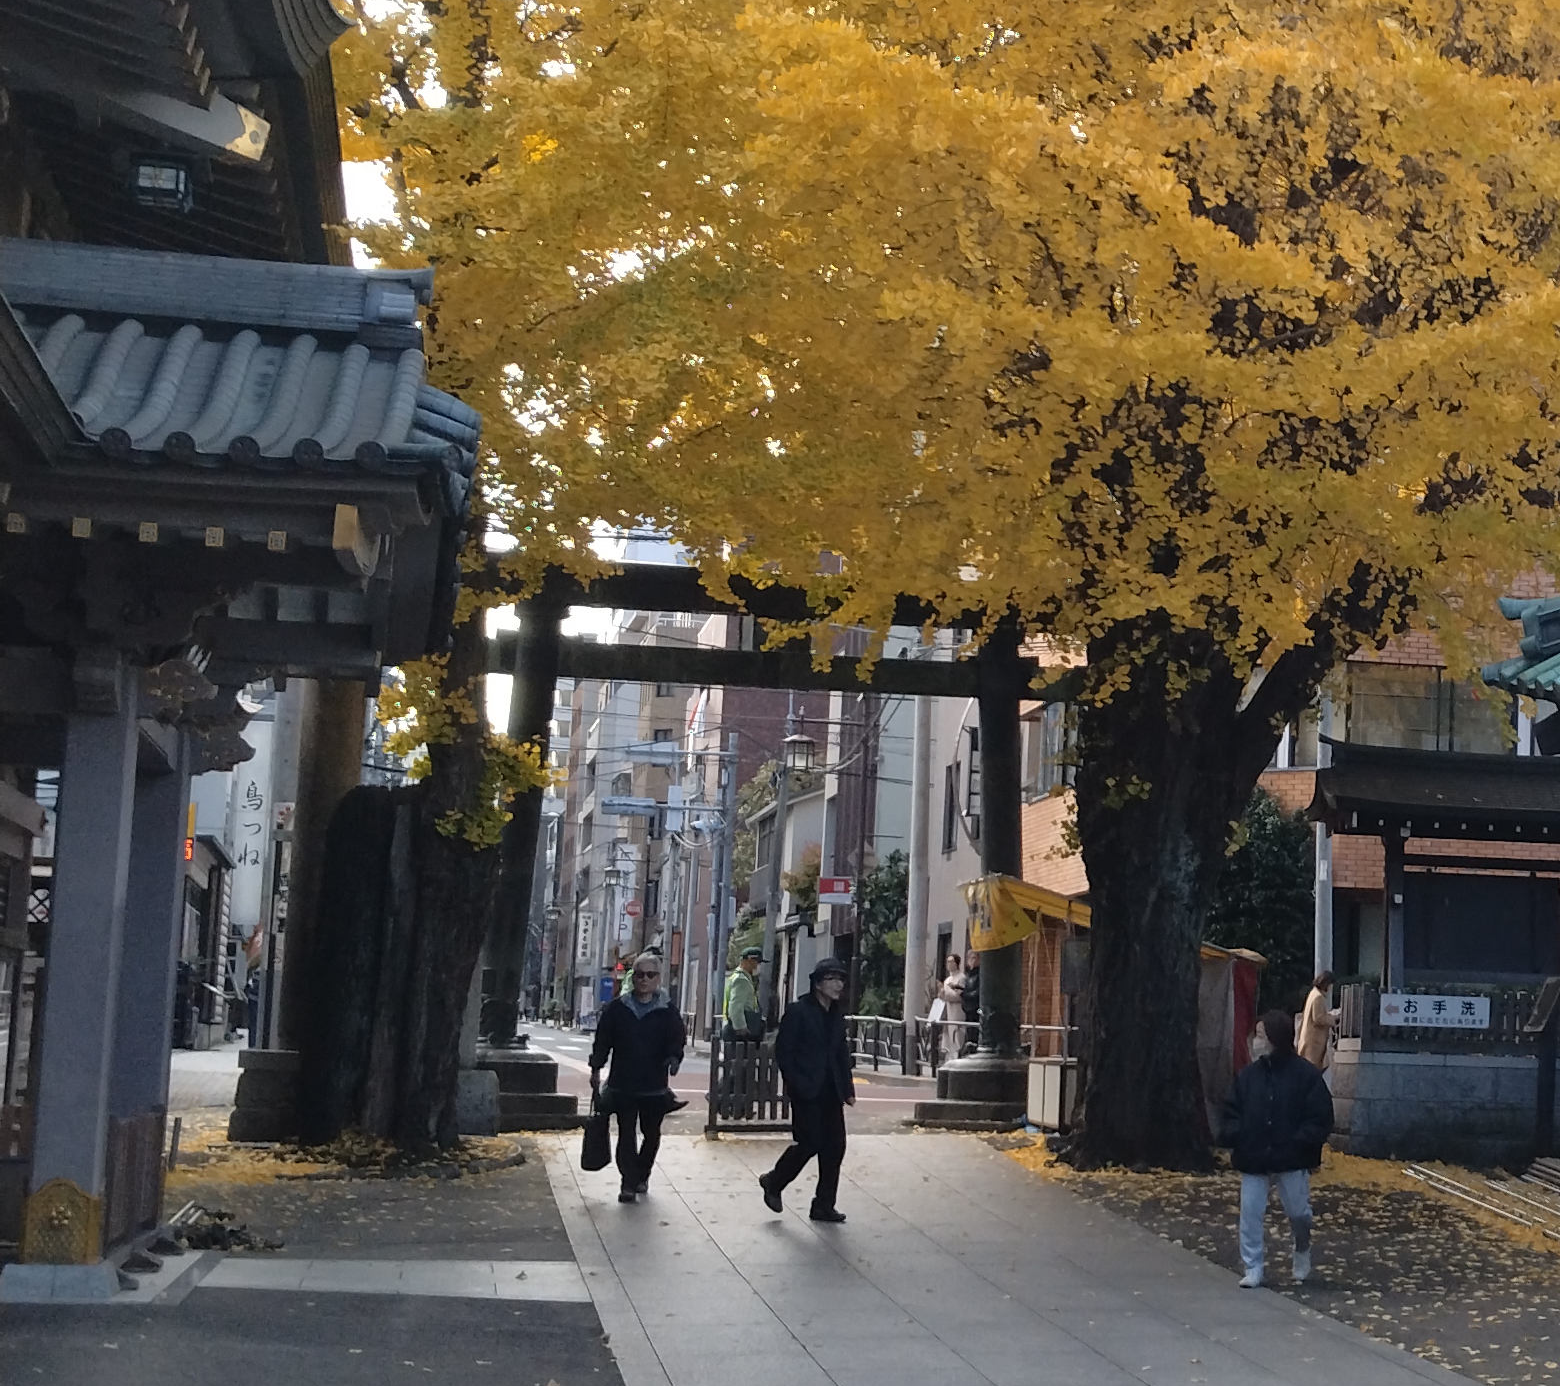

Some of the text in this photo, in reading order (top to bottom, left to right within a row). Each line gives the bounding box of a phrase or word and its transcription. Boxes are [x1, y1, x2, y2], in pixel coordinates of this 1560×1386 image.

[237, 780, 264, 867] 鳥つね
[1403, 998, 1476, 1016] お手洗
